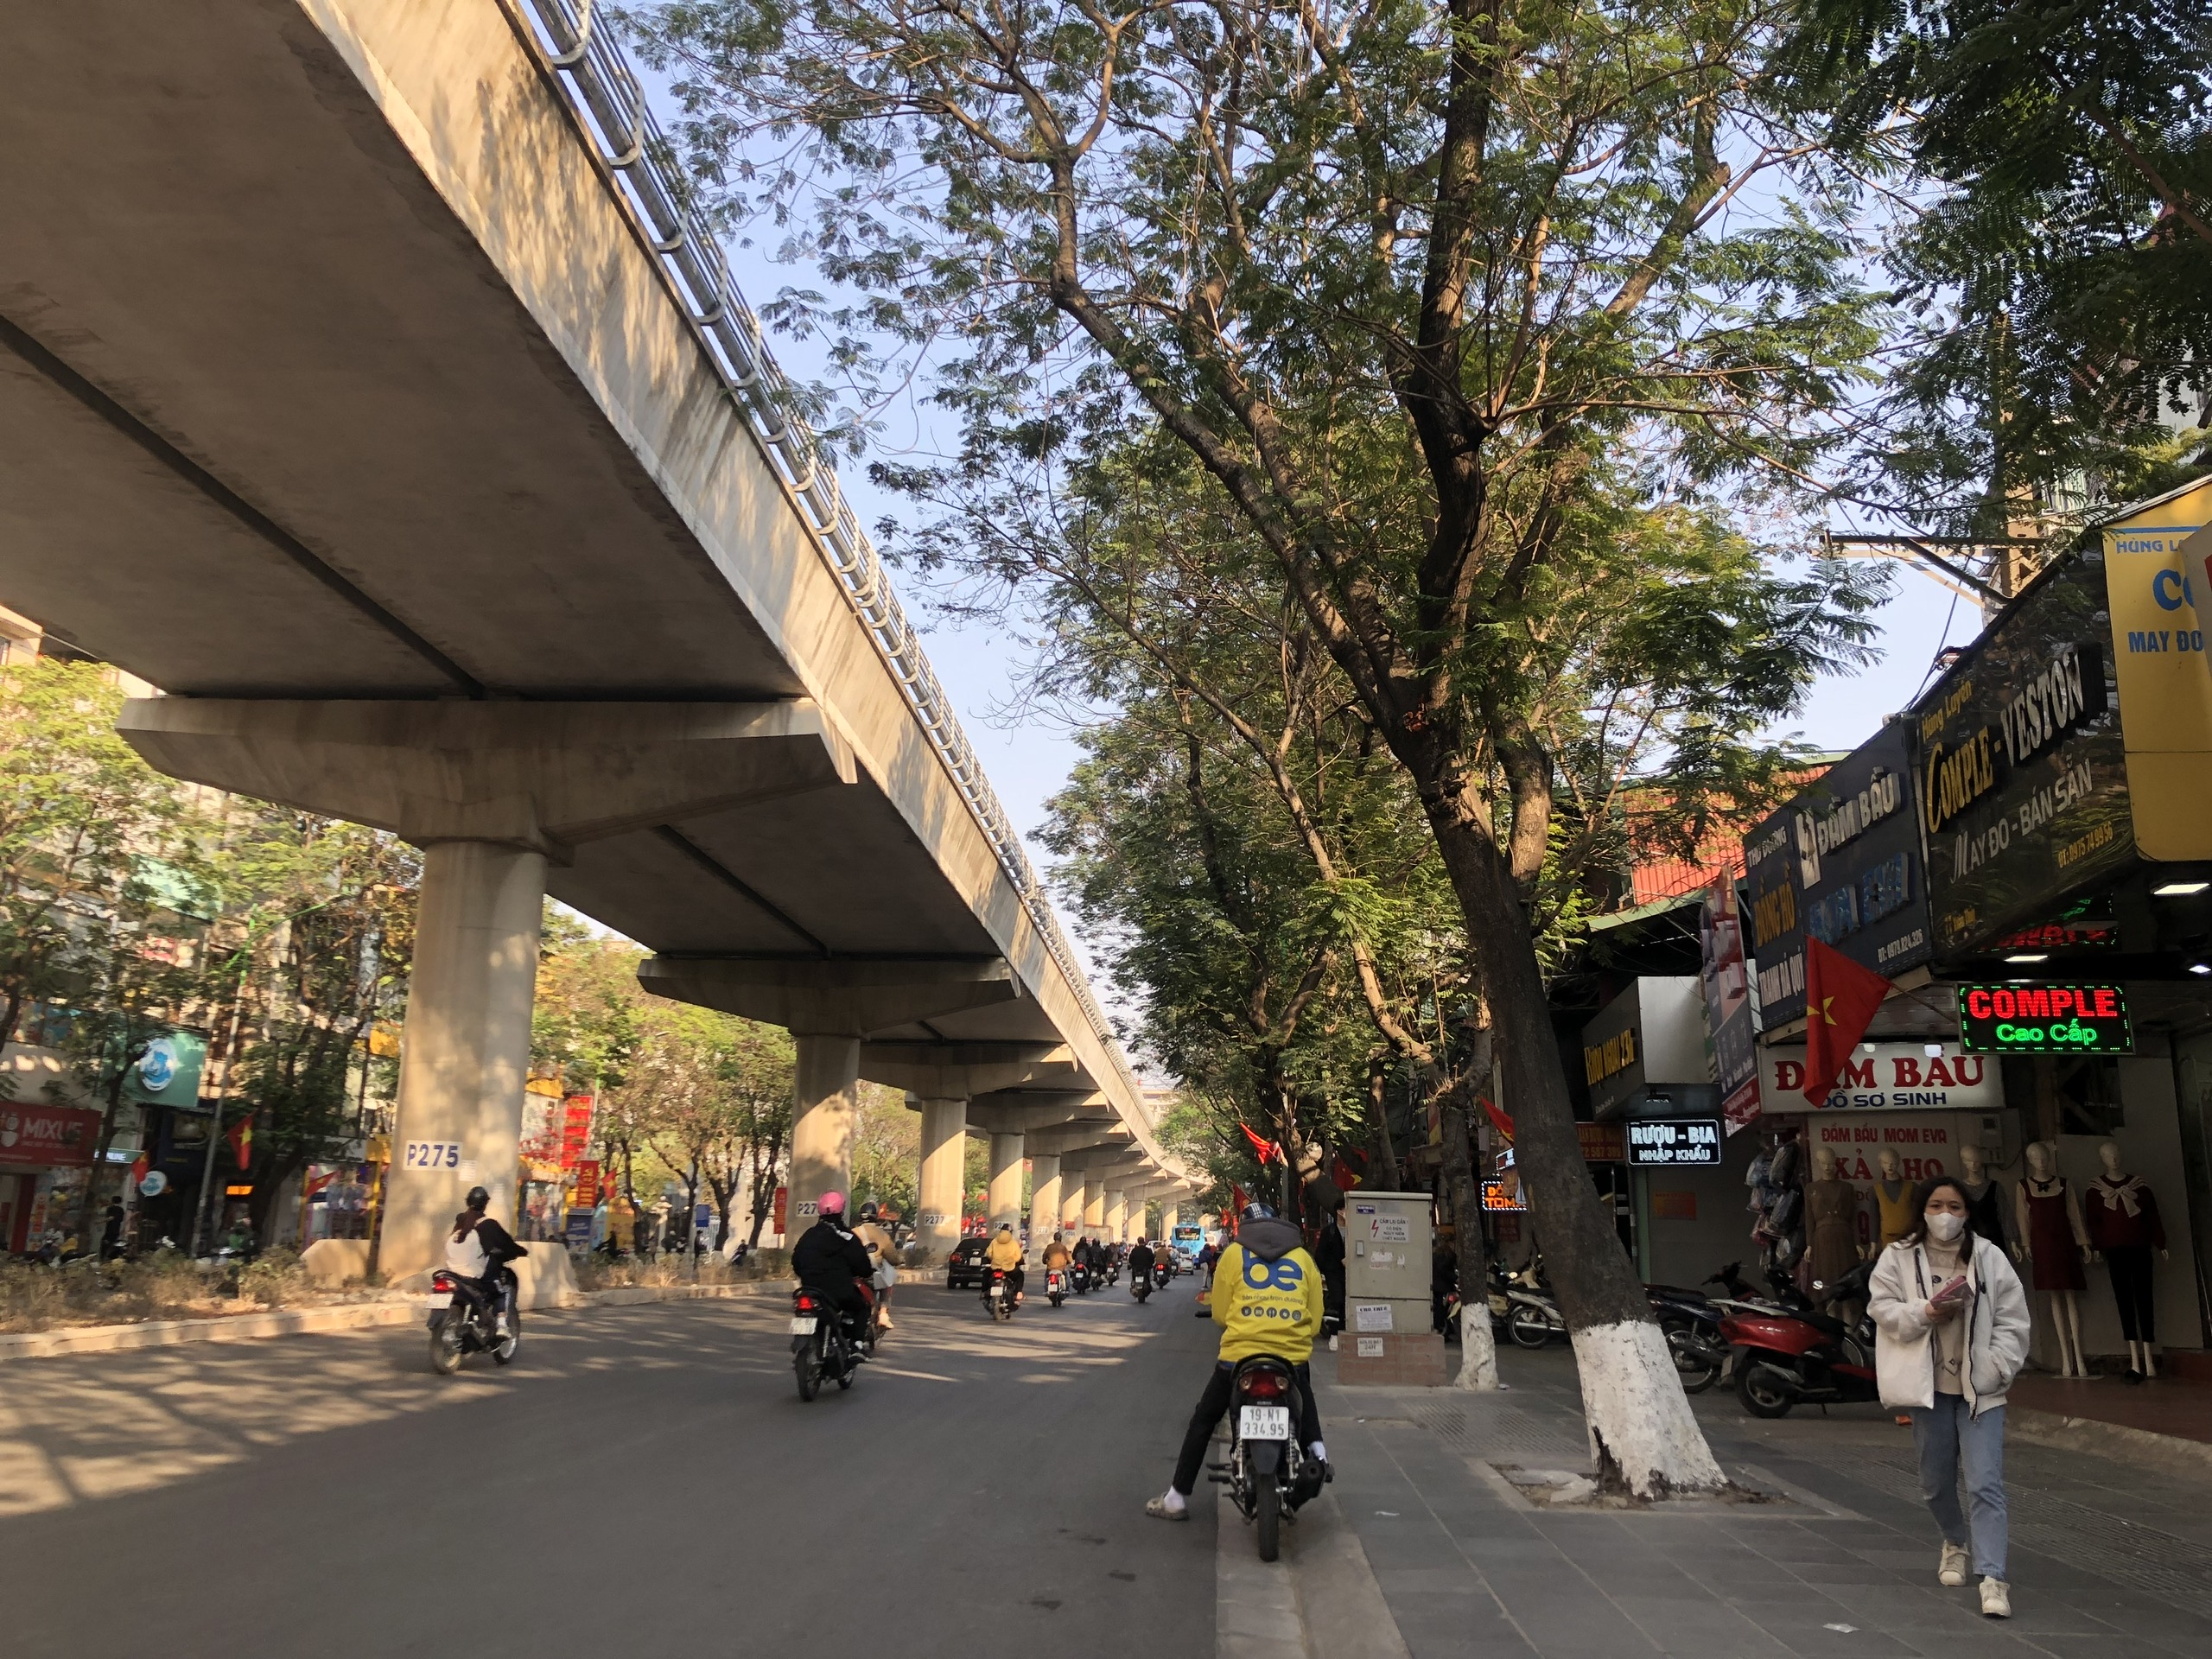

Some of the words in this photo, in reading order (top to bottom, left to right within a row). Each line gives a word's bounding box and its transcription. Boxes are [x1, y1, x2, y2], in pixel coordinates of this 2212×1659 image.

[2116, 537, 2164, 553] HÙNG
[2128, 631, 2170, 653] MAY
[2176, 630, 2203, 652] ĐO
[1926, 725, 1994, 834] COMPLE
[1950, 830, 1986, 885] MAY
[1988, 817, 2010, 859] ĐO
[2018, 785, 2054, 836] BÁN
[1968, 989, 2118, 1019] COMPLE
[1996, 1024, 2044, 1042] Cao
[2050, 1018, 2097, 1046] Cấp
[1775, 1058, 1878, 1091] ĐM
[1853, 1092, 1885, 1108] SƠ
[1892, 1091, 1948, 1106] SINH
[1630, 1124, 1676, 1148] RƯỢU
[1688, 1126, 1717, 1144] BIA
[1884, 1128, 1919, 1143] MOM
[1923, 1128, 1948, 1144] EVA
[407, 1144, 459, 1167] P275
[1639, 1147, 1674, 1163] NHẬP
[1882, 1158, 1945, 1180] HO
[798, 1203, 819, 1215] P27
[925, 1216, 945, 1224] P277
[1242, 1246, 1303, 1292] be
[1249, 1408, 1280, 1421] 19-N1
[1244, 1422, 1285, 1437] 334.95
